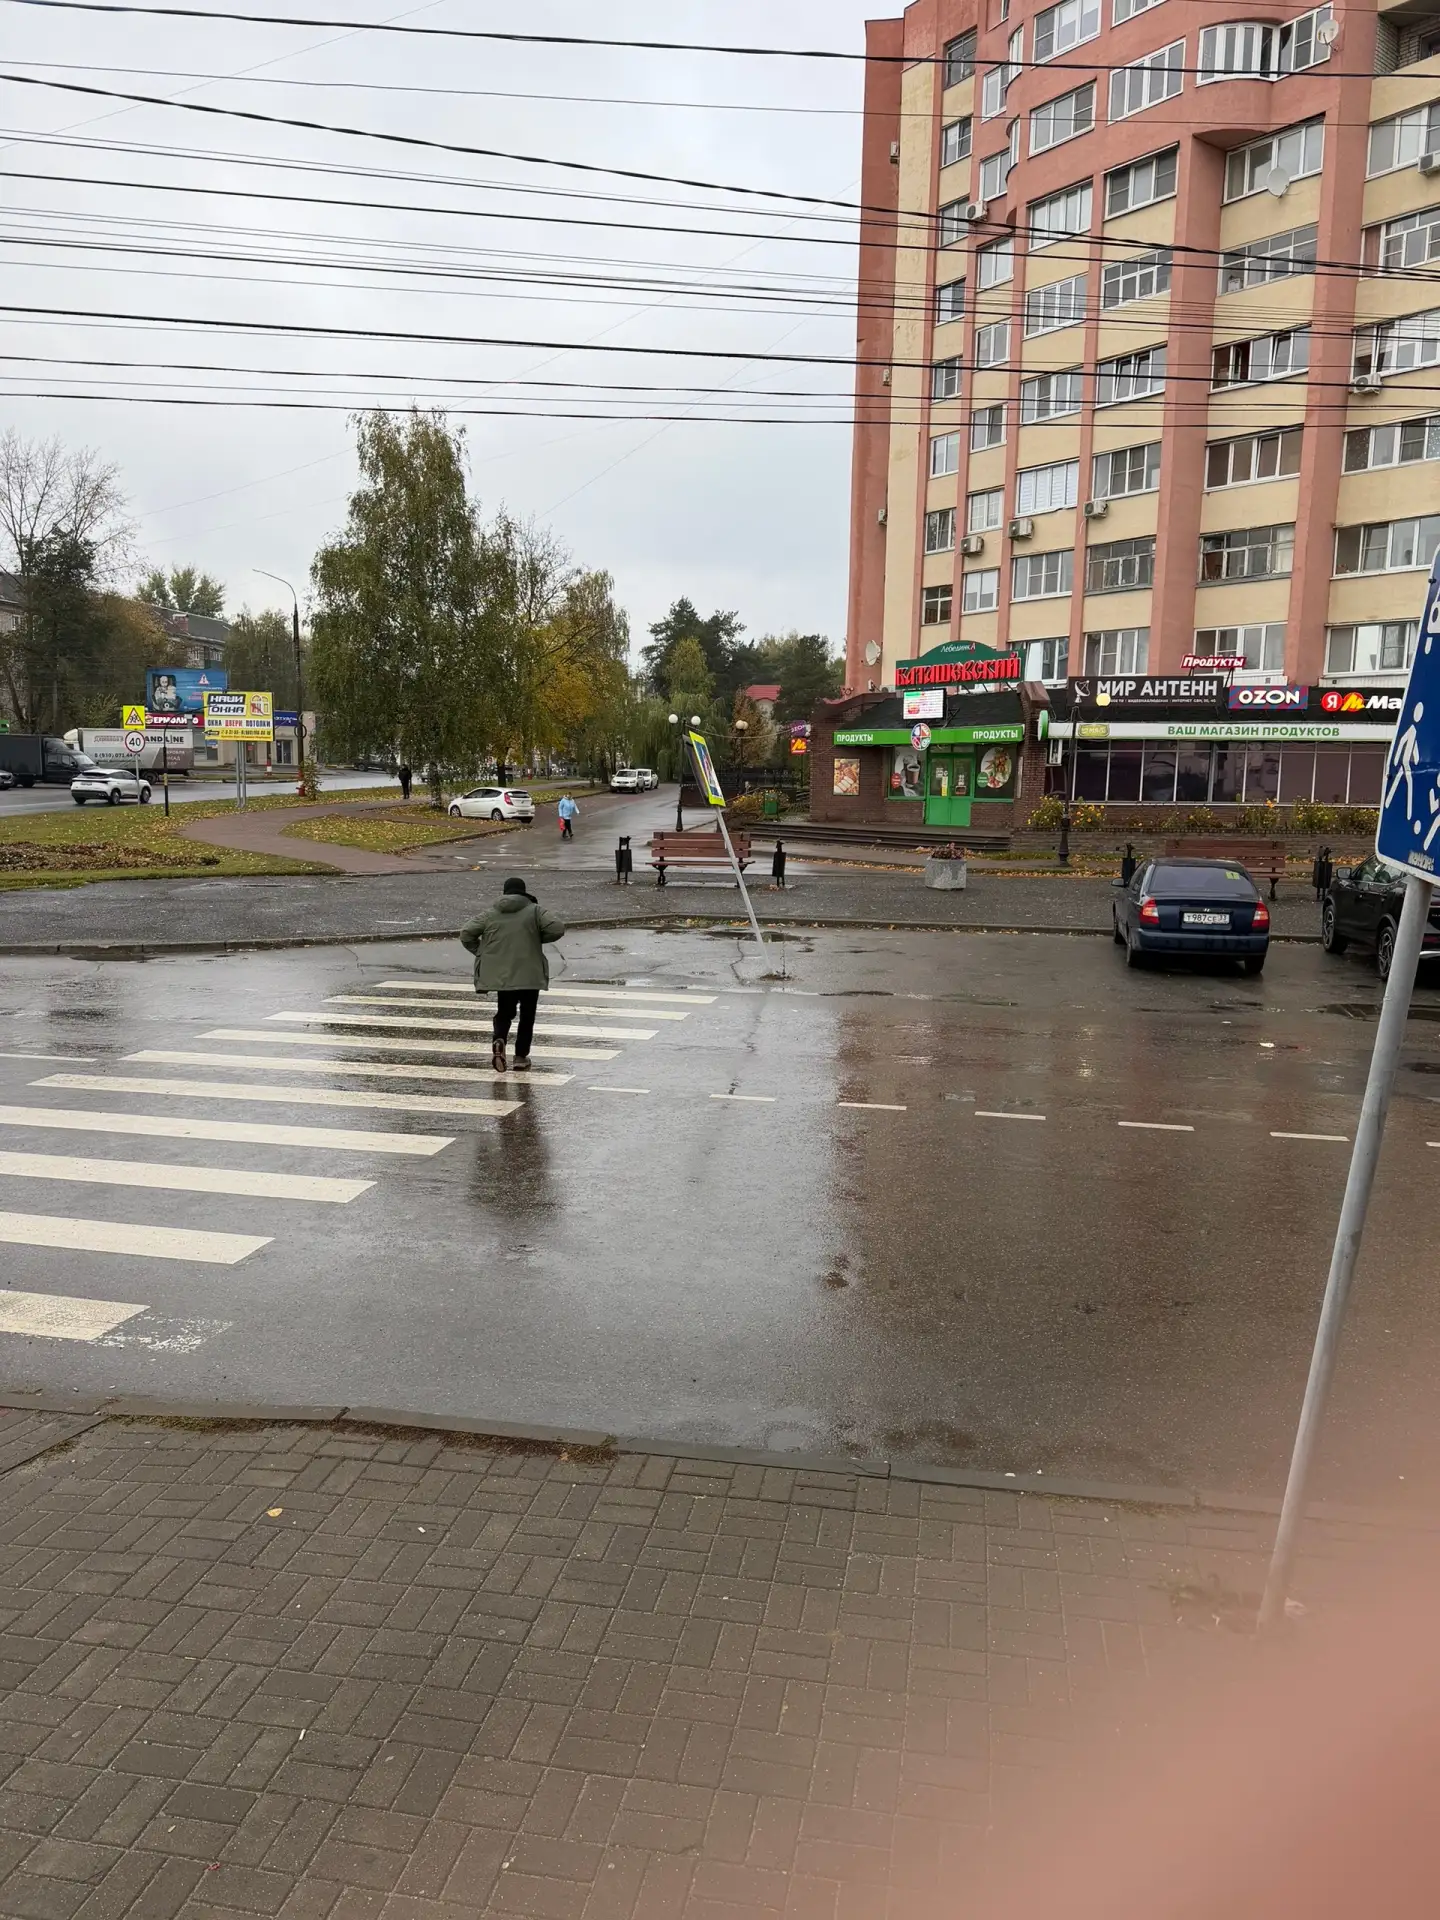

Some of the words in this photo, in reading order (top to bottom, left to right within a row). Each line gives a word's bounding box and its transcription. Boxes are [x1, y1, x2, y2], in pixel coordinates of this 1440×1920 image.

[1097, 680, 1136, 697] МИР
[1140, 681, 1218, 696] АНТЕНН
[1238, 690, 1300, 704] OZON
[153, 716, 199, 724] ЕРМОЛИО
[972, 729, 1019, 740] ПРОДУКТЫ
[1167, 726, 1197, 735] ВАШ
[1199, 726, 1260, 736] МАГАЗИН
[1262, 727, 1340, 737] ПРОДУКТОВ
[128, 738, 142, 747] 40
[836, 733, 874, 743] ПРОДУКТЫ
